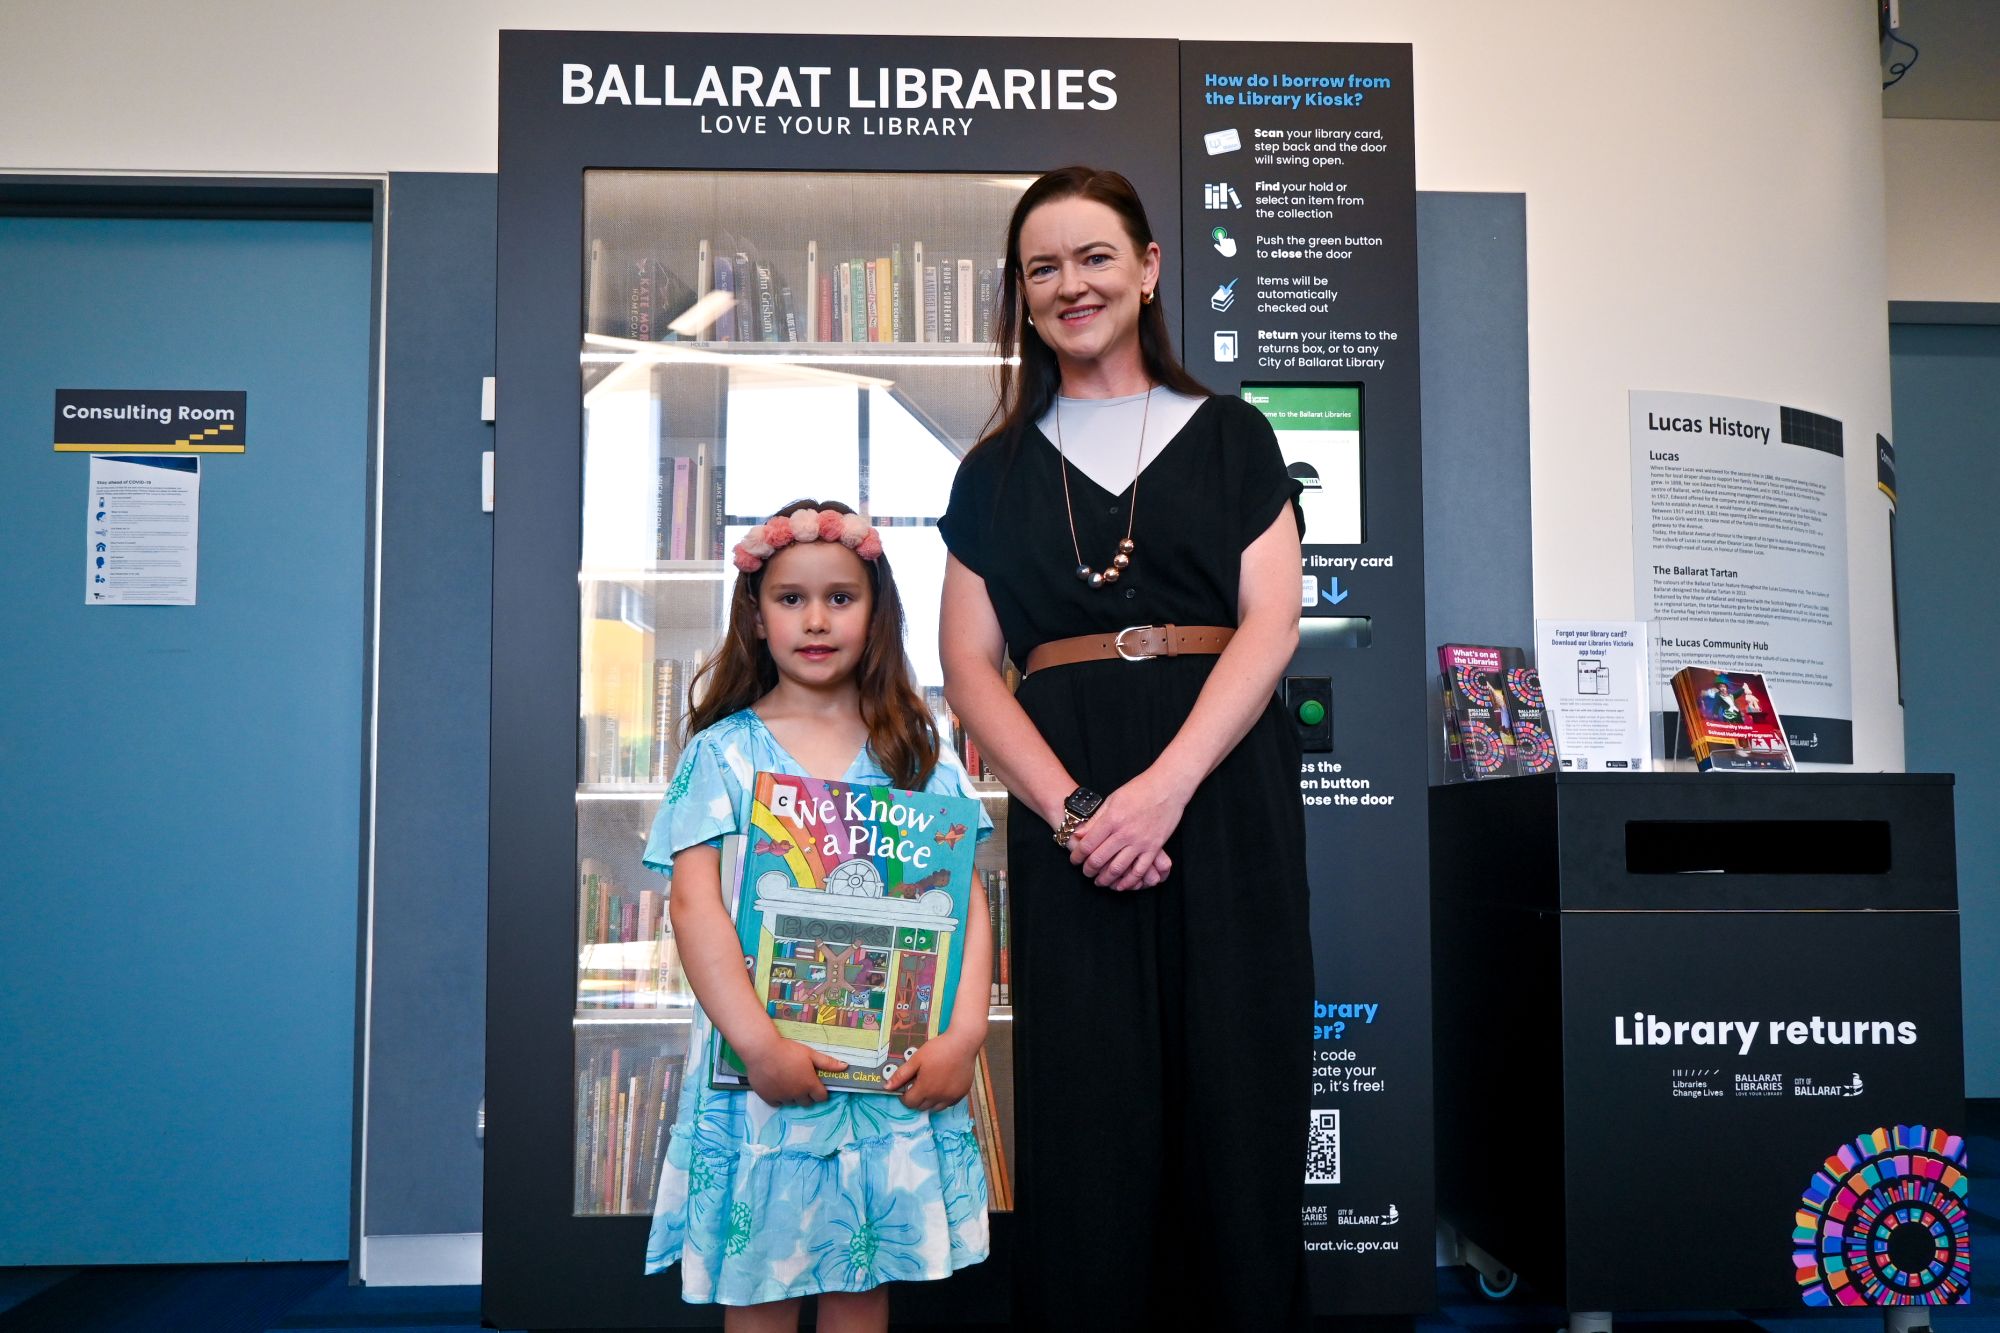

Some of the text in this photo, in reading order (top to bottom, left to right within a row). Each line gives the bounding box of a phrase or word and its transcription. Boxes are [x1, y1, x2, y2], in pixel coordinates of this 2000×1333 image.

[562, 63, 1118, 111] BALLARAT LIBRARIES
[1206, 74, 1390, 88] How do I borrow from
[1206, 91, 1363, 109] the Library Kiosk?
[701, 116, 974, 137] LOVE YOUR LIBRARY
[1255, 129, 1383, 141] Scan your library card,
[1255, 142, 1387, 153] step back and the door
[1255, 155, 1344, 167] will swing open.
[1256, 181, 1280, 191] Find
[1282, 184, 1306, 193] your
[1309, 182, 1333, 191] hold
[1256, 195, 1288, 204] select
[1309, 195, 1334, 205] item
[1337, 196, 1364, 205] from
[1256, 209, 1332, 218] the collection
[1257, 236, 1382, 248] Push the green button
[1257, 249, 1352, 258] to close the door
[1258, 276, 1328, 285] Items will be
[640, 278, 649, 308] KATE
[1257, 290, 1337, 301] automatically
[758, 267, 773, 332] John Grisham
[631, 288, 639, 338] HOMECOM
[1258, 303, 1328, 312] checked out
[1258, 330, 1397, 342] Return your items to the
[1259, 344, 1299, 353] returns
[1303, 344, 1325, 354] box,
[1343, 345, 1354, 353] to
[1357, 346, 1378, 356] any
[1259, 357, 1384, 370] City of Ballarat Library
[63, 404, 234, 424] Consulting Room
[1648, 412, 1770, 445] Lucas History
[1649, 450, 1679, 462] Lucas
[1311, 555, 1357, 570] library
[1361, 556, 1393, 567] card
[1653, 565, 1738, 578] The Ballarat Tartan
[1555, 630, 1575, 638] Forgot
[1589, 630, 1609, 638] library
[1610, 630, 1627, 638] card?
[1675, 638, 1701, 648] Lucas
[1702, 639, 1751, 651] Community
[1753, 641, 1769, 651] Hub
[1453, 649, 1478, 657] What's
[1489, 651, 1497, 659] at
[1467, 658, 1498, 666] Libraries
[1317, 761, 1341, 772] the
[1321, 778, 1370, 789] button
[778, 796, 788, 807] C
[1302, 794, 1394, 806] lose the door
[798, 792, 934, 832] We Know
[823, 825, 931, 868] a Place
[783, 916, 890, 945] BOOKS
[1314, 1000, 1378, 1024] brary
[1615, 1011, 1917, 1055] Library returns
[1321, 1049, 1356, 1061] code
[853, 1071, 881, 1083] Clarke
[1312, 1065, 1376, 1080] eate your
[1735, 1074, 1782, 1082] BALLARAT
[1329, 1080, 1349, 1092] it's
[1353, 1080, 1384, 1092] free!
[1735, 1083, 1783, 1091] LIBRARIES
[1795, 1086, 1841, 1096] BALLARAT
[1673, 1089, 1724, 1099] Change Lives
[1302, 1206, 1327, 1214] LARAT
[1338, 1216, 1379, 1225] BALLARAT
[1304, 1240, 1399, 1253] larat.vic.gov.au
